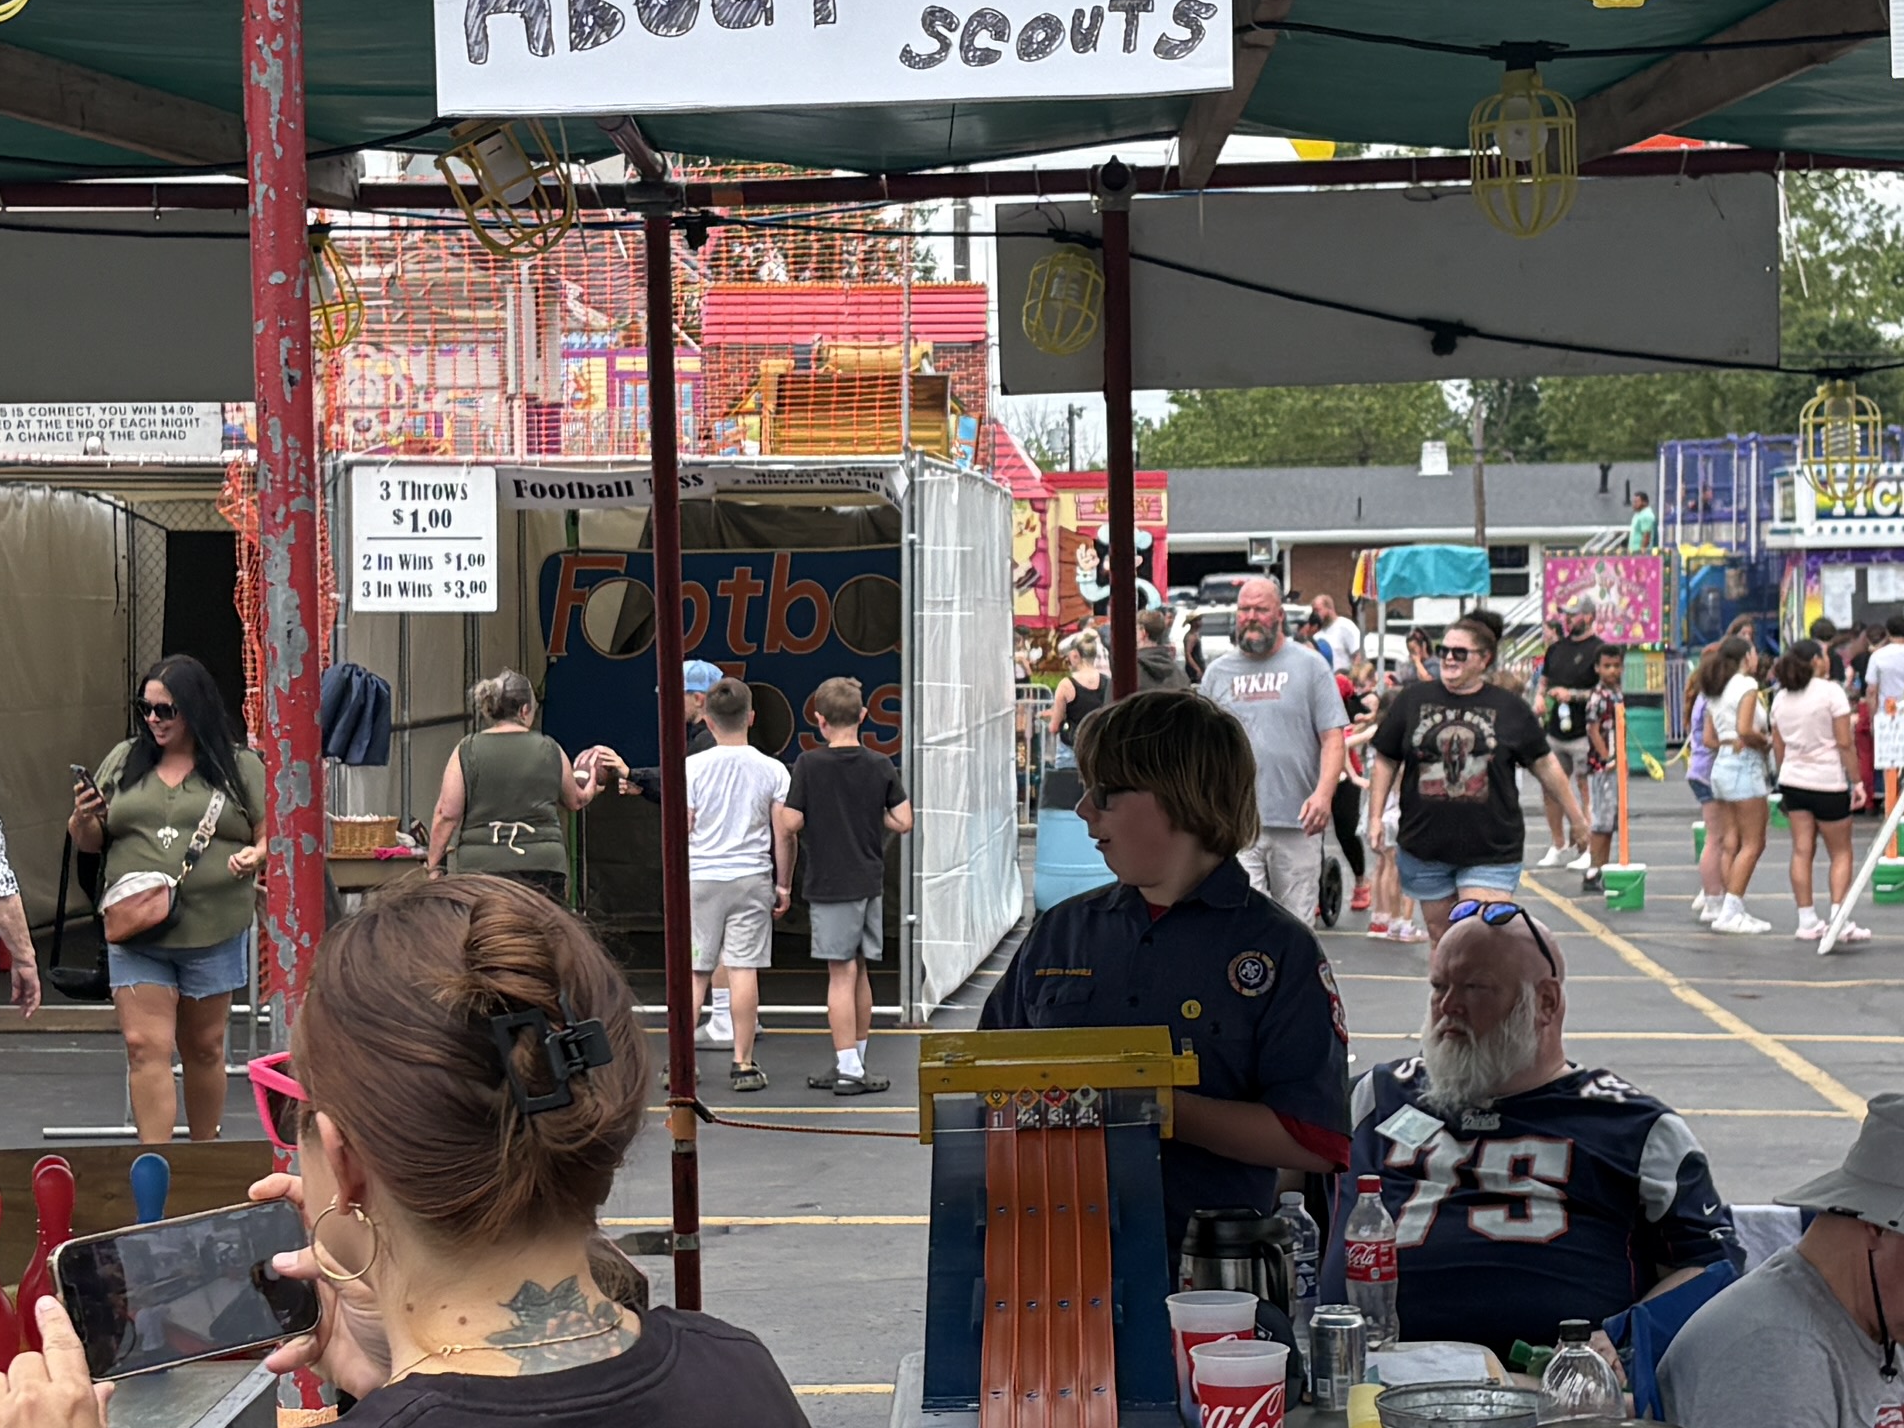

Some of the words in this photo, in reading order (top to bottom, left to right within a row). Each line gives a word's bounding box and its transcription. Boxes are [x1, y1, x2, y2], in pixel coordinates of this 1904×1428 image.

[12, 407, 25, 418] IS
[100, 406, 128, 417] YOU
[131, 405, 157, 417] WIN
[15, 419, 33, 430] AT
[35, 419, 63, 430] THE
[66, 418, 94, 430] END
[98, 418, 116, 429] OF
[119, 418, 157, 429] EACH
[160, 417, 201, 428] NIGHT
[5, 432, 15, 443] A
[18, 431, 75, 443] CHANCE
[109, 430, 136, 441] THE
[139, 429, 187, 441] GRAND
[379, 480, 391, 501] 3
[398, 480, 468, 501] Throws
[512, 478, 635, 500] Football
[643, 473, 705, 496] Tss
[392, 508, 452, 533] $1.00
[362, 553, 372, 571] 2
[377, 553, 393, 571] In
[398, 553, 434, 571] Wins
[444, 552, 486, 571] $1.00
[362, 580, 371, 598] 3
[376, 580, 392, 598] In
[398, 580, 433, 598] Wins
[443, 579, 487, 599] $3.00
[545, 551, 902, 660] Footba
[1232, 671, 1289, 696] WKRP
[1384, 1128, 1575, 1250] 75
